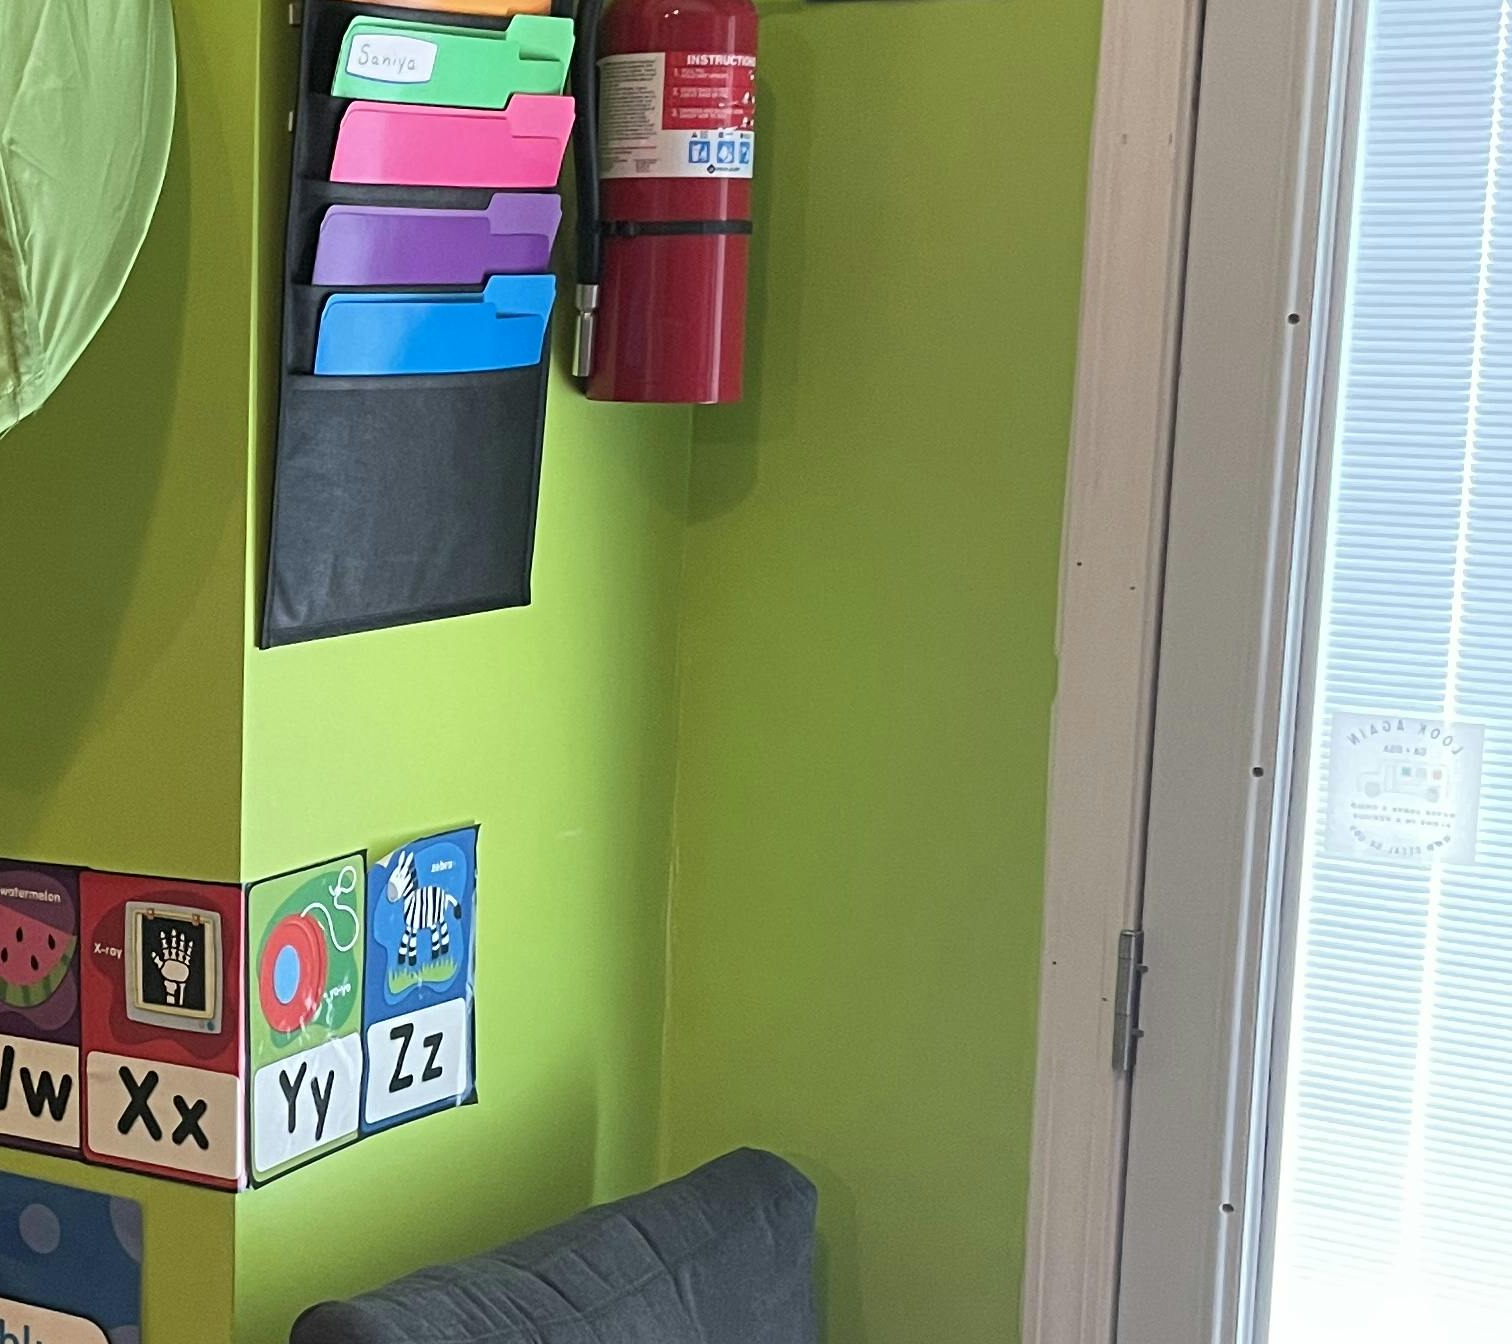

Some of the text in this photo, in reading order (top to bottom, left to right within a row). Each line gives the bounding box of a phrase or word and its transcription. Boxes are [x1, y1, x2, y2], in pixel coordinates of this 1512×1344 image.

[358, 43, 416, 74] Saniya
[0, 886, 62, 903] watermelon
[93, 942, 123, 960] X-ray
[388, 1022, 445, 1094] Zz
[117, 1065, 209, 1150] Xx
[279, 1061, 336, 1140] Yy
